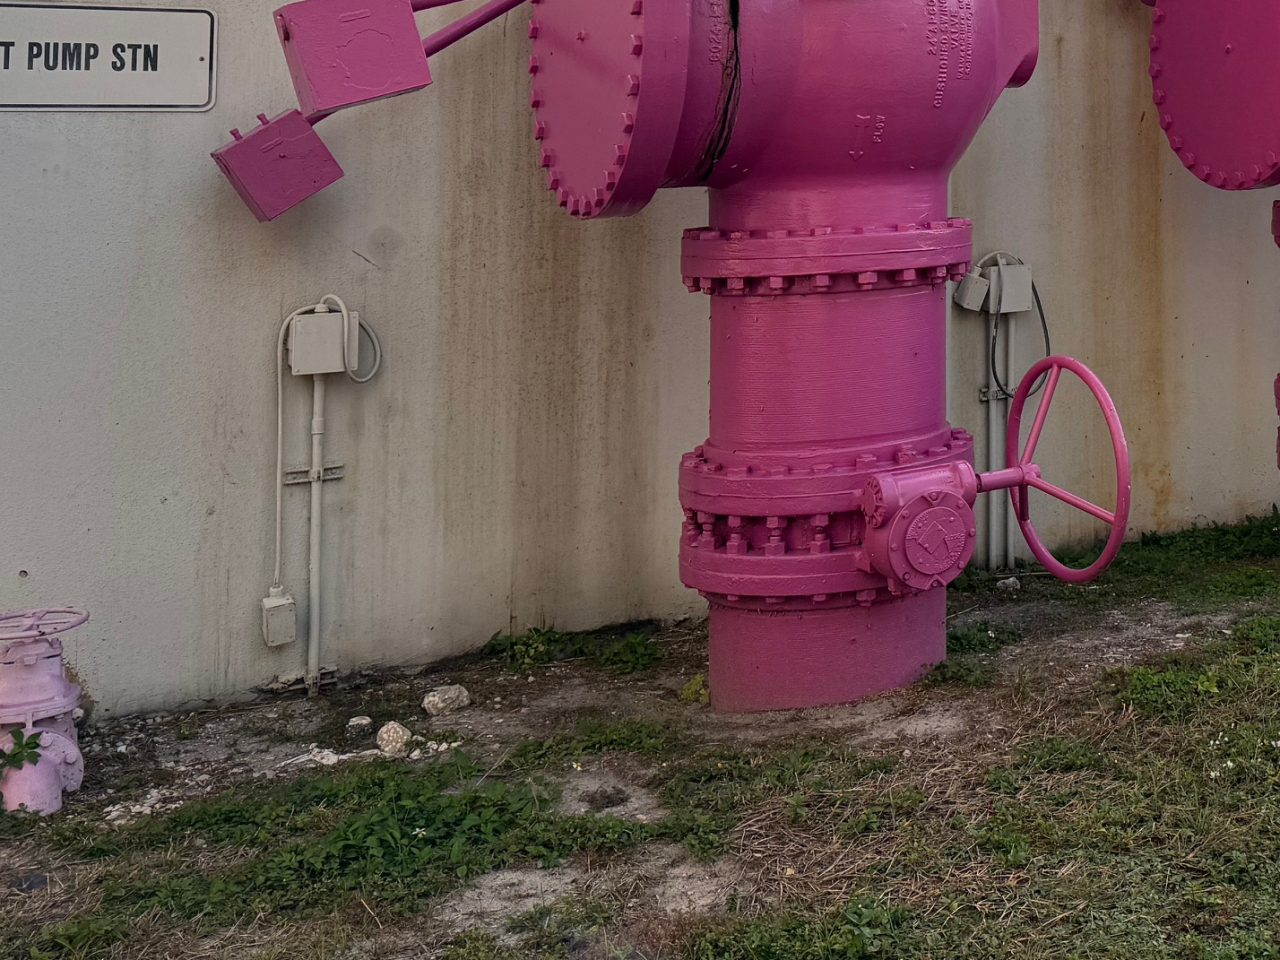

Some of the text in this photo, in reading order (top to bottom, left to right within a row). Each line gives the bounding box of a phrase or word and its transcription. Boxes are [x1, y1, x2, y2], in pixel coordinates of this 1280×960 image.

[27, 41, 99, 71] PUMP
[111, 43, 159, 72] STN
[872, 114, 886, 144] FLOW
